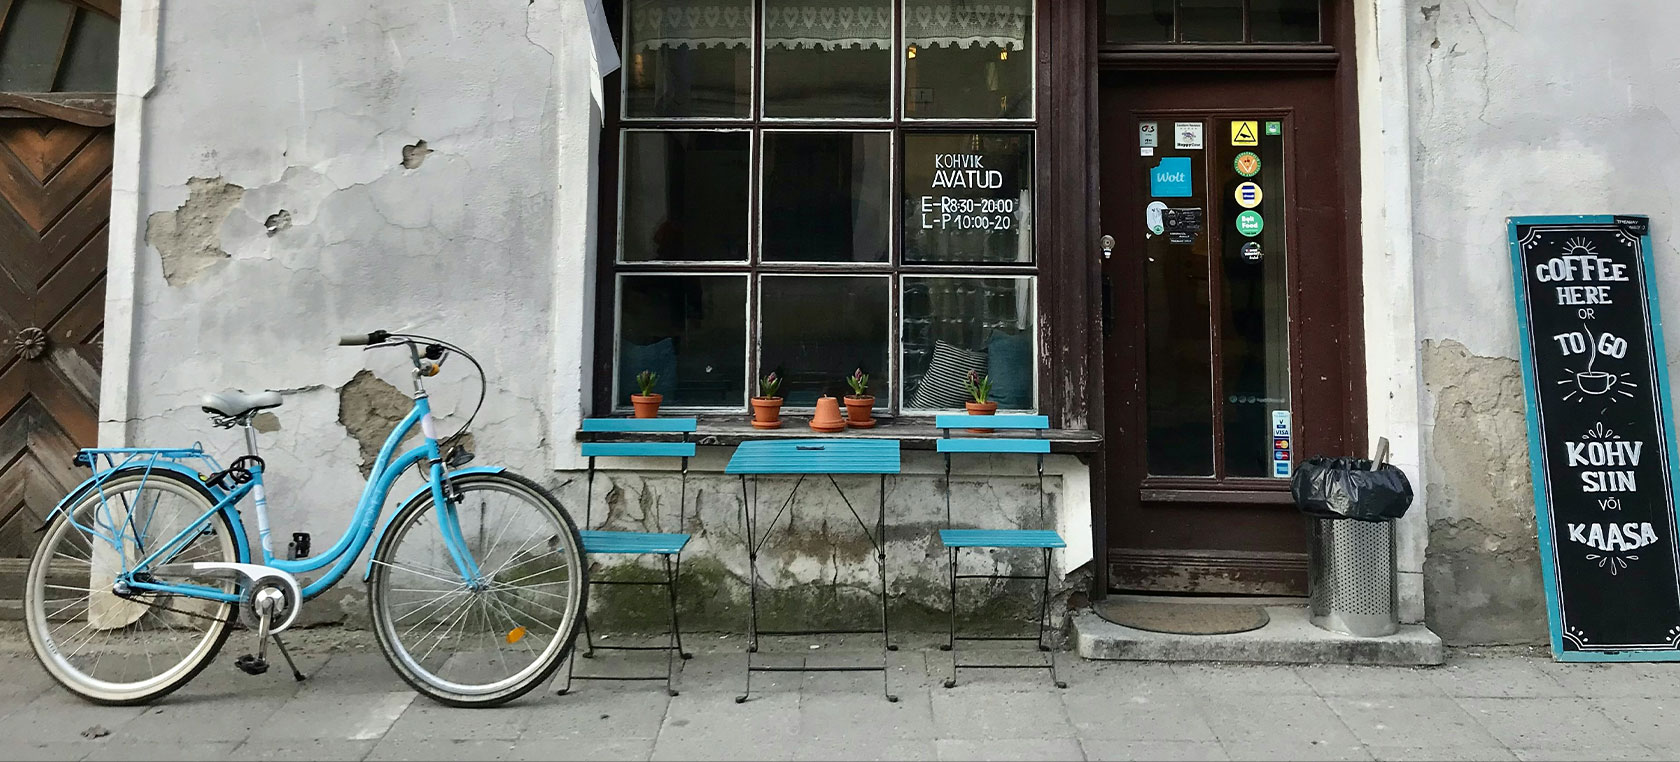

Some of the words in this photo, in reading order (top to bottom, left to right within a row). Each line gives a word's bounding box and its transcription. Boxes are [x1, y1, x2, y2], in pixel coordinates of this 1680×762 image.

[935, 154, 984, 168] KOHVIK
[931, 170, 1003, 189] AVATUD
[1157, 172, 1185, 182] Wolt
[922, 213, 951, 230] L-P
[954, 214, 1011, 230] 10:00-20
[1536, 255, 1629, 282] COFFEE
[1556, 286, 1613, 305] HERE
[1578, 308, 1596, 320] OR
[1553, 331, 1587, 356] TO
[1597, 332, 1628, 359] GO
[1565, 441, 1643, 467] KOHV
[1581, 470, 1637, 492] SIIN
[1567, 522, 1659, 551] KAASA
